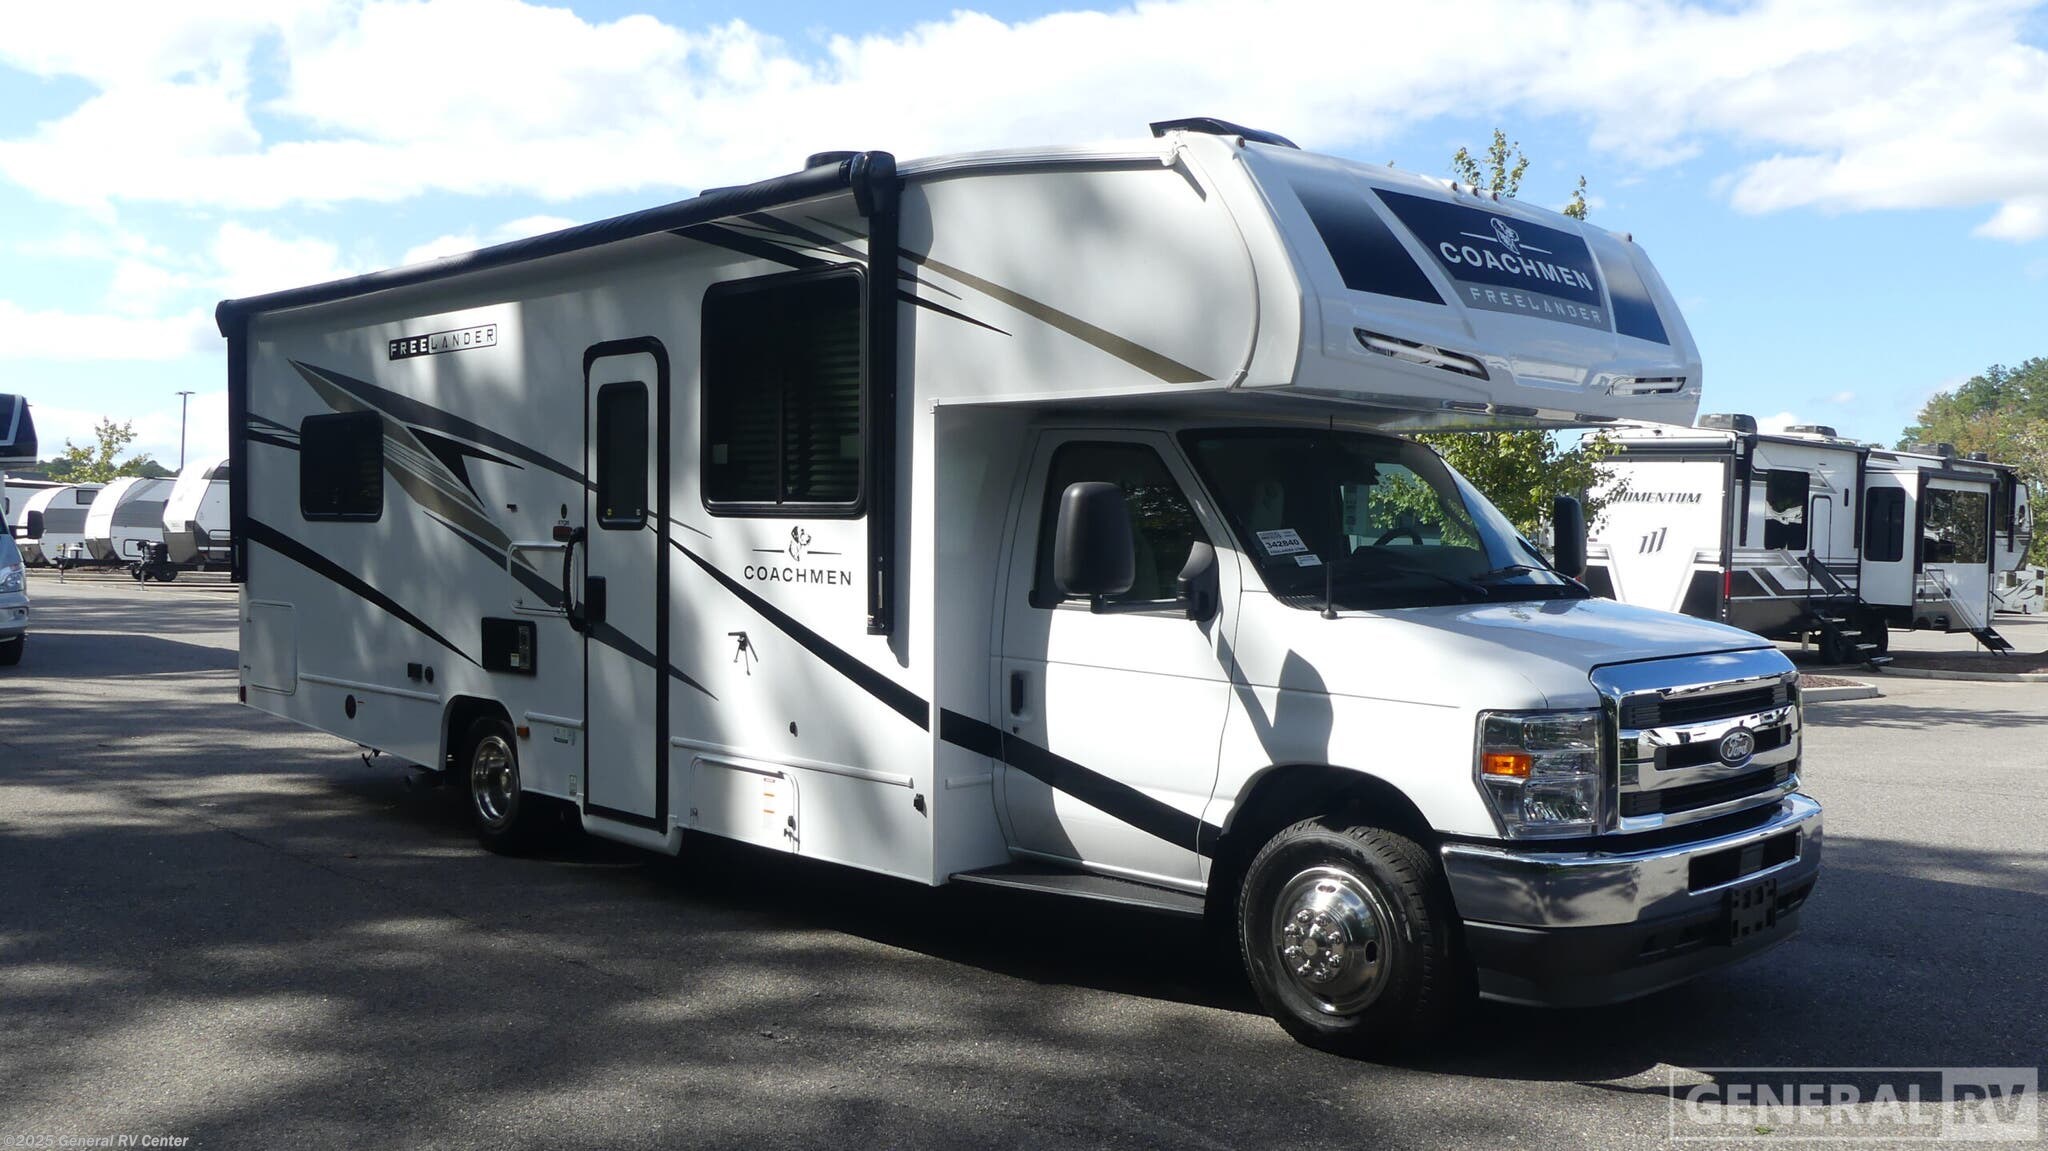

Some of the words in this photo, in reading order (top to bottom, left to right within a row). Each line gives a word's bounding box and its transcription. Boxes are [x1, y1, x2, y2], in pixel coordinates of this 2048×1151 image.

[1439, 241, 1594, 291] COACHMEN
[1469, 287, 1602, 323] FREELANDER
[744, 565, 852, 586] COACHMEN
